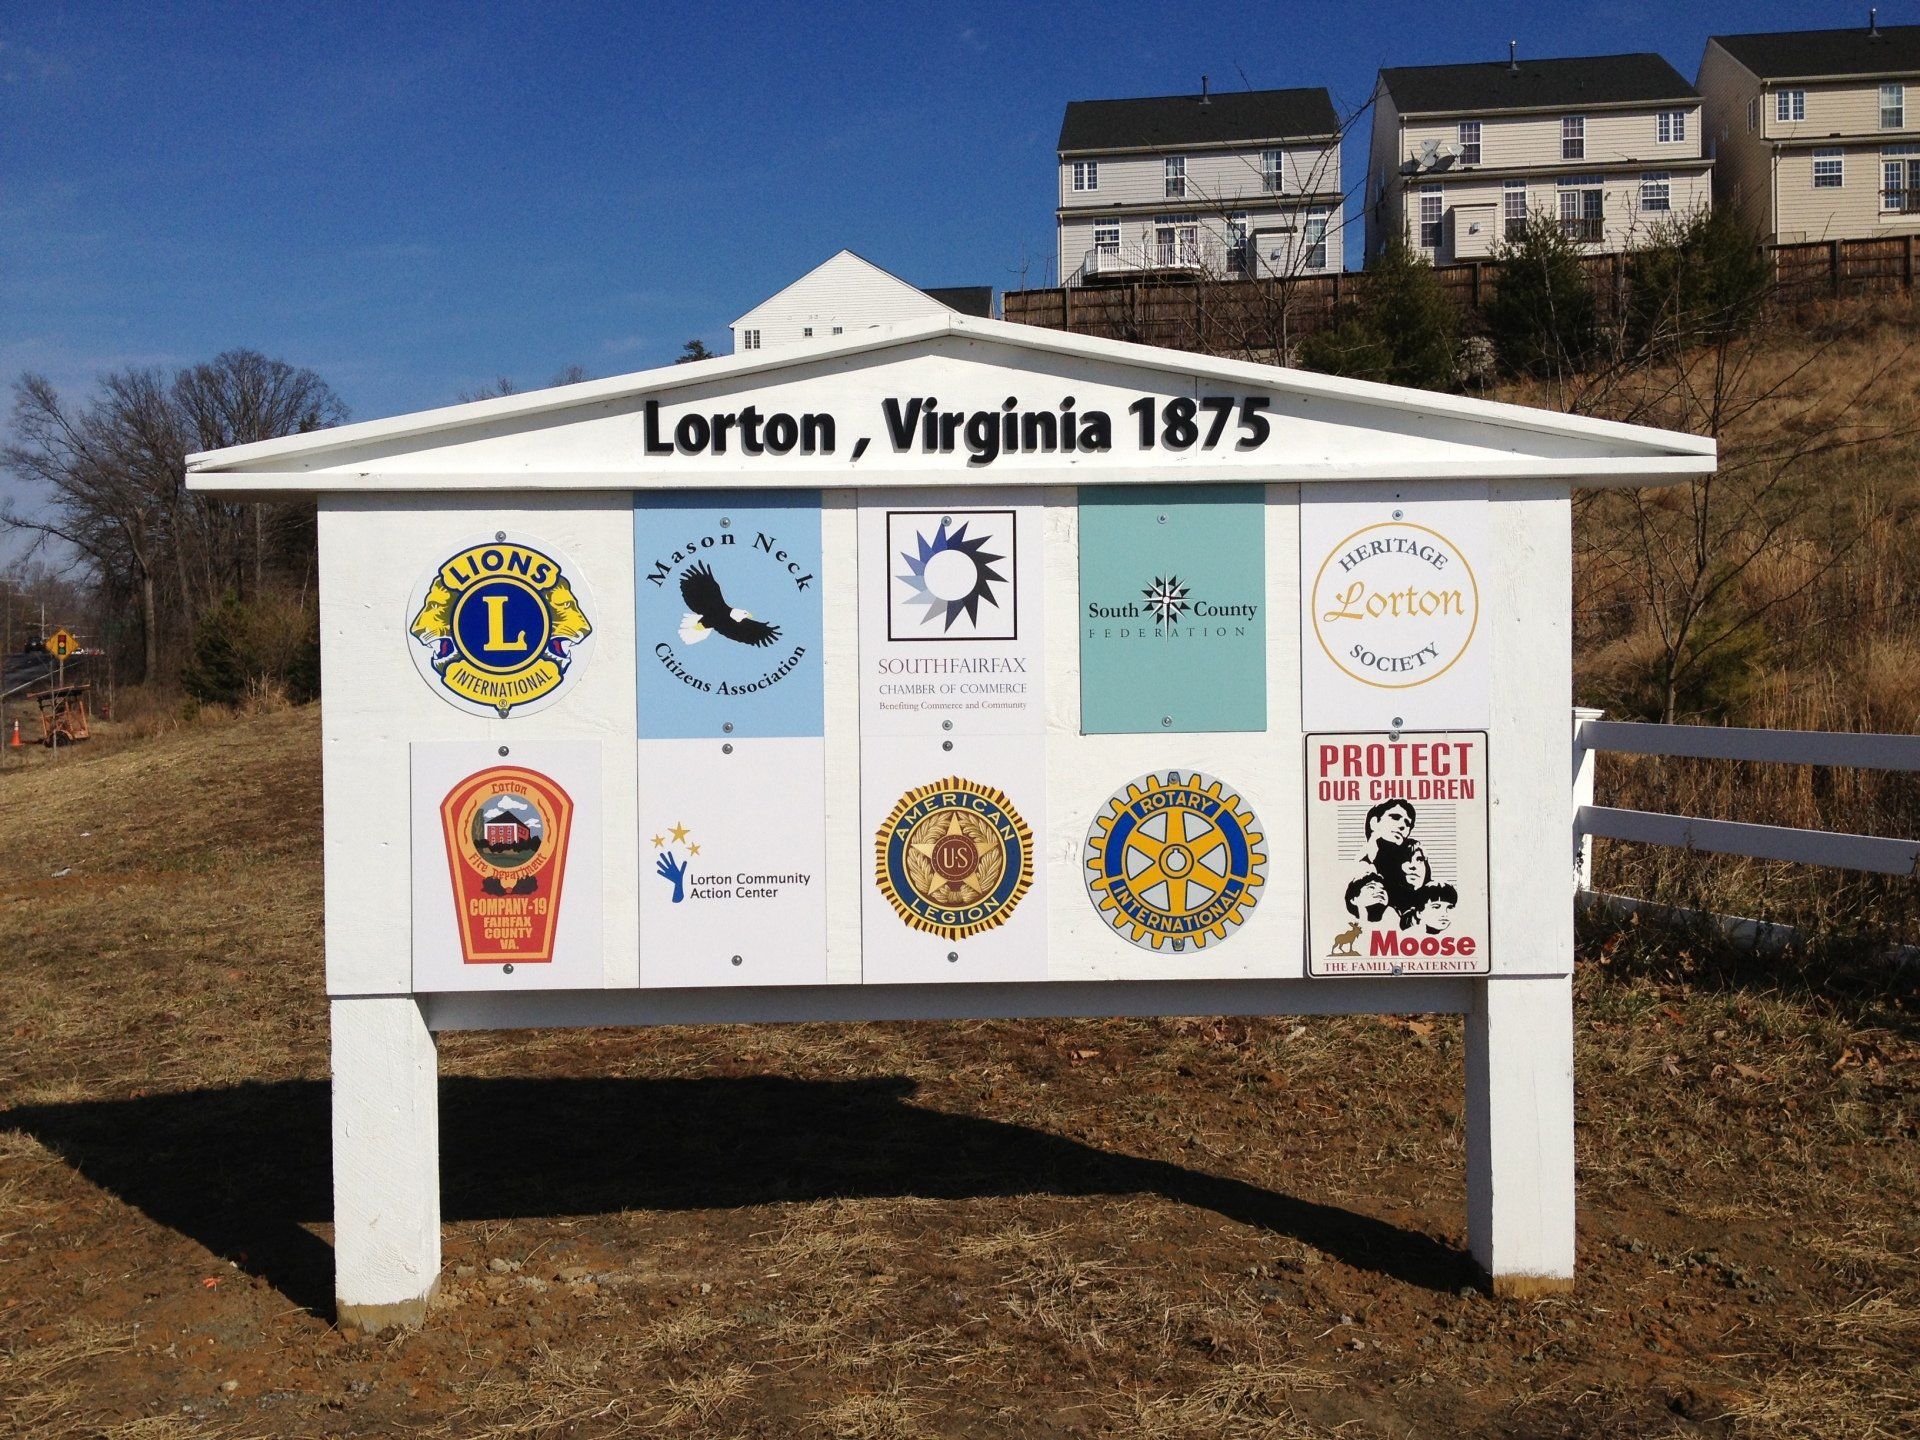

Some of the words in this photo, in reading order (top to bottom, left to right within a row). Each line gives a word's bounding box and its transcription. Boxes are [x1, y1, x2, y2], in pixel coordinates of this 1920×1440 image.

[882, 395, 1112, 468] Virginia
[1128, 396, 1271, 452] 1875
[449, 549, 552, 586] LIONS
[645, 533, 736, 588] Mason
[752, 531, 813, 592] Neck
[1337, 537, 1448, 574] HERITAGE
[1088, 602, 1139, 619] South
[1193, 601, 1258, 621] County
[1323, 581, 1464, 623] Lorton
[482, 595, 527, 651] L
[1089, 626, 1246, 639] FEDERATION
[655, 642, 711, 693] Citizens
[716, 645, 806, 696] Association
[1349, 642, 1439, 672] SOCIETY
[452, 668, 553, 697] INTERNATIONAL
[879, 684, 936, 695] CHAMBER
[939, 684, 956, 694] OF
[960, 683, 1027, 694] COMMERCE
[879, 701, 919, 711] Benefiting
[921, 701, 963, 710] Commerce
[965, 701, 980, 709] and
[981, 700, 1027, 711] Community
[1319, 742, 1474, 778] PROTECT
[491, 780, 528, 796] Lorton
[1318, 780, 1360, 801] OUR
[1369, 779, 1475, 801] CHILDREN
[1140, 791, 1214, 814] ROTARY
[895, 793, 1015, 842] AMERICAN
[468, 852, 488, 873] Fire
[492, 851, 547, 881] Department
[690, 874, 732, 886] Lorton
[736, 872, 810, 886] Community
[690, 887, 731, 899] Action
[736, 886, 779, 898] Center
[470, 897, 547, 917] COMPANY-19
[910, 896, 1000, 924] LEGION
[1113, 885, 1240, 932] INTERNATIONAL
[483, 917, 532, 928] FAIRFAX
[484, 927, 532, 939] COUNTY
[499, 938, 520, 950] VA.
[1369, 930, 1476, 957] Moose
[1324, 961, 1348, 972] THE
[1400, 960, 1478, 972] FRATERNITY
